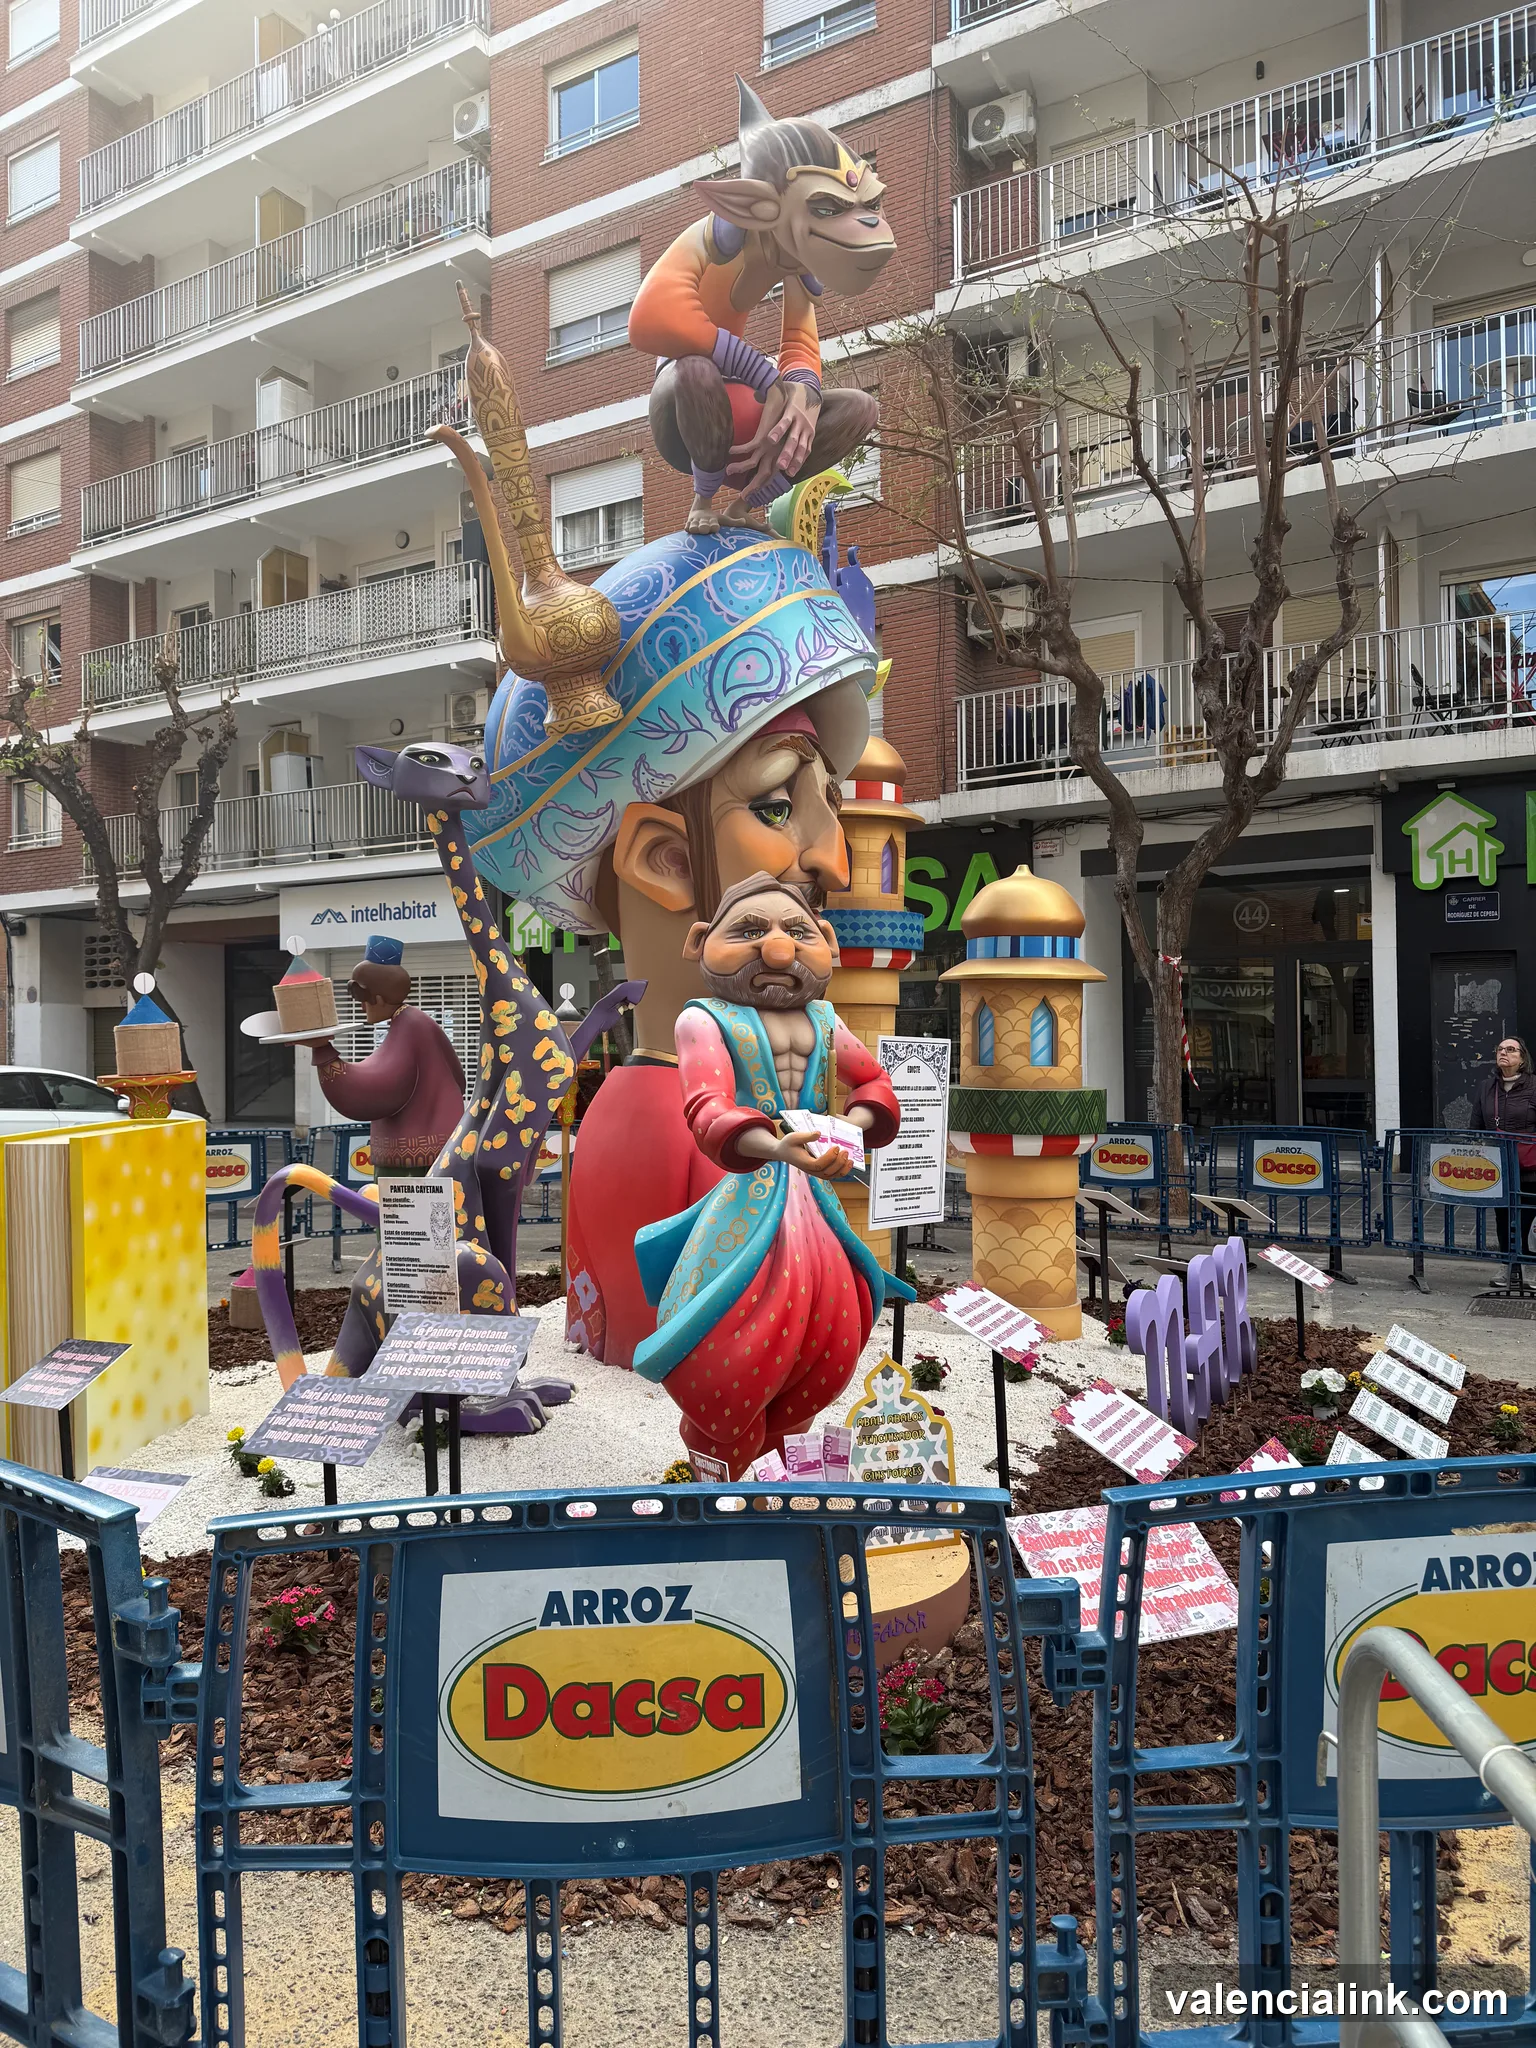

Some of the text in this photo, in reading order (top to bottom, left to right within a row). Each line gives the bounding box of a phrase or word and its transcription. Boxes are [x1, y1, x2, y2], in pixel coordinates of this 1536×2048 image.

[351, 900, 437, 923] intelhabitat
[1238, 905, 1264, 925] 44
[1108, 1137, 1136, 1145] ARROZ
[1098, 1149, 1149, 1166] Dacsa
[1275, 1146, 1303, 1154] ARROZ
[206, 1164, 246, 1178] acsa
[1262, 1158, 1317, 1175] Dacsa
[1439, 1161, 1496, 1181] Dacsa
[390, 1185, 444, 1194] PANTERA CAYETANA
[413, 1326, 508, 1340] La Pantera Cayetana
[390, 1339, 518, 1354] veus en ganes desbocades,
[385, 1352, 511, 1366] sent guerrera, d'ultradreta
[382, 1366, 395, 1375] en
[398, 1365, 412, 1376] les
[413, 1367, 448, 1379] sarpes
[449, 1368, 503, 1380] esmolades.
[301, 1389, 390, 1407] Cara al sol està ficada
[284, 1403, 386, 1422] remirant el temps passat,
[887, 1411, 924, 1424] ABALOS
[1110, 1418, 1127, 1431] grans
[1125, 1408, 1140, 1419] fums
[273, 1417, 287, 1428] per
[316, 1420, 331, 1431] del
[1135, 1415, 1158, 1434] problemes
[289, 1434, 309, 1445] gent
[310, 1433, 325, 1446] hui
[324, 1434, 341, 1448] l'ha
[340, 1437, 369, 1450] votat!
[823, 1435, 833, 1462] 500
[1135, 1441, 1154, 1456] merda
[786, 1445, 799, 1472] 500
[885, 1450, 899, 1461] DE
[1040, 1560, 1059, 1576] no
[1058, 1557, 1078, 1574] es
[1420, 1552, 1536, 1592] ARRO
[539, 1585, 693, 1627] ARROZ
[482, 1662, 765, 1741] Dacsa
